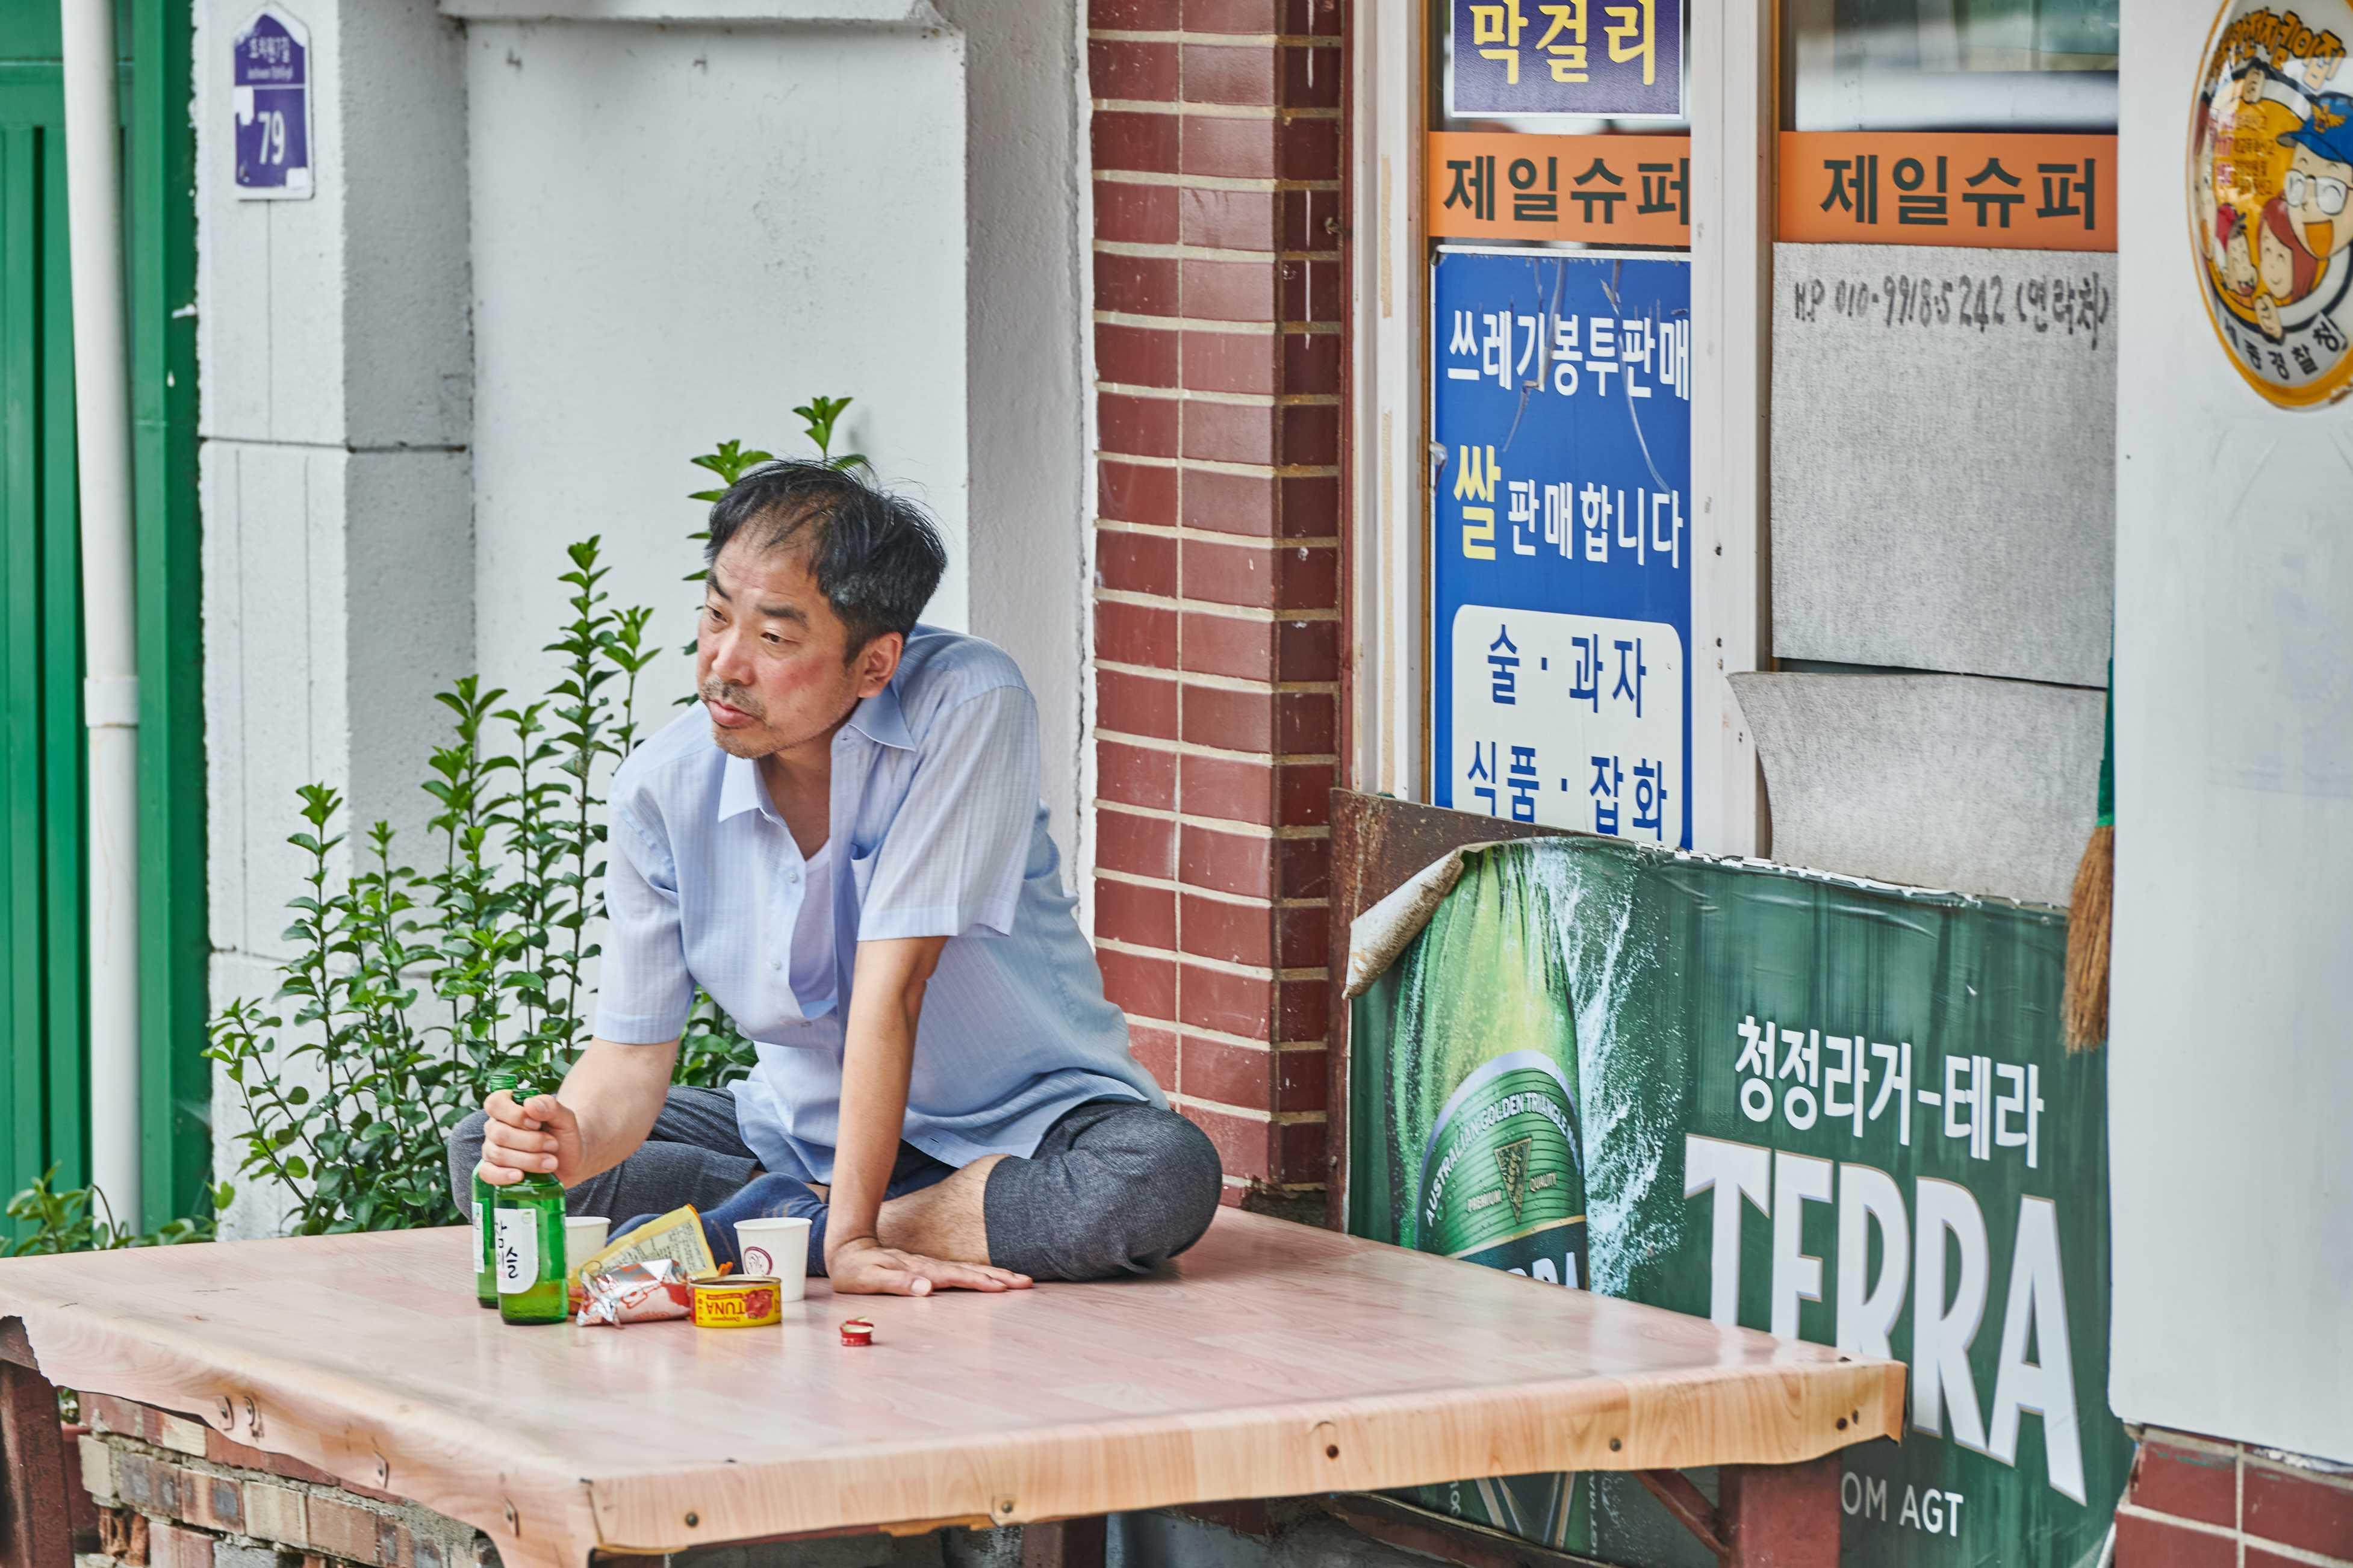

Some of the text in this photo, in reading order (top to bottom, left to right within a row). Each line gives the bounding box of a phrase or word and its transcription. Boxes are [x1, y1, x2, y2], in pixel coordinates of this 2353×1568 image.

[1469, 0, 1655, 85] 막걸리
[256, 110, 286, 166] 79
[1443, 155, 1691, 226] 제일슈퍼
[1819, 155, 2097, 231] 제일슈퍼
[1447, 310, 1689, 401] 쓰레기봉투판매
[1453, 444, 1683, 569] 쌀 판매합니다
[1735, 1015, 2045, 1170] 청정라거-테라
[1425, 1121, 1479, 1229] AUSTRALIAN
[1480, 1094, 1524, 1132] GOLDEN
[1529, 1171, 1557, 1192] QUALITY
[1466, 1188, 1503, 1213] PREMIUM
[706, 1300, 745, 1315] TUNA
[1683, 1132, 2087, 1507] TERRA
[1841, 1470, 1964, 1537] OM AGT
